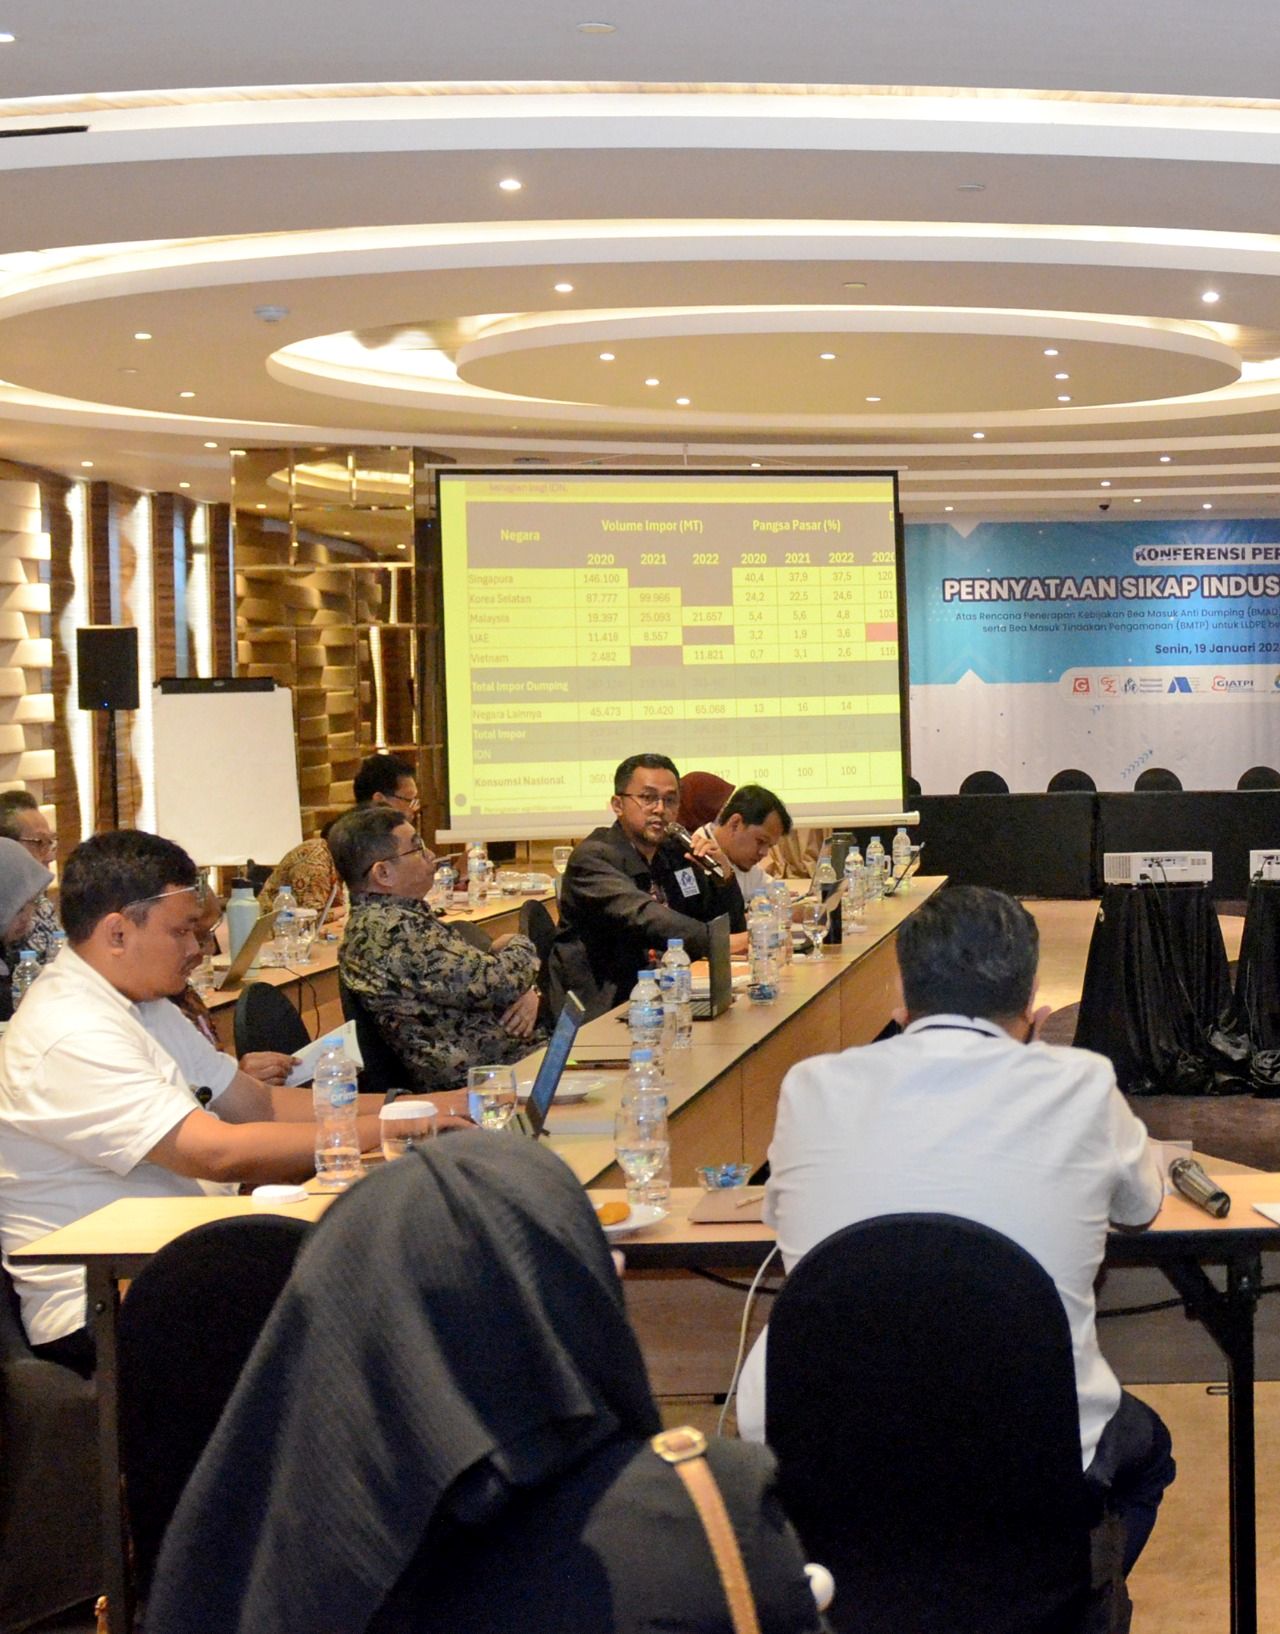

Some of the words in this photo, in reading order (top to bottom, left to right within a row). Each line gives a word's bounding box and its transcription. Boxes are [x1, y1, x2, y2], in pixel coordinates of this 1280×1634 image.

[602, 520, 643, 532] Volume
[646, 520, 677, 533] Impor
[680, 520, 703, 533] (MT)
[753, 520, 790, 532] Pangsa
[793, 520, 821, 531] Pasar
[824, 520, 841, 533] (%)
[501, 530, 541, 543] Negara
[587, 554, 614, 565] 2020
[640, 553, 667, 565] 2021
[692, 553, 719, 565] 2022
[740, 553, 767, 564] 2020
[785, 553, 810, 564] 2021
[829, 552, 854, 563] 2022
[1135, 547, 1246, 561] KONFERENSI
[468, 574, 513, 585] Singapura
[584, 574, 620, 583] 146.100
[745, 573, 764, 583] 40,4
[789, 572, 808, 583] 37,9
[832, 571, 851, 582] 37,5
[877, 571, 893, 580] 120
[944, 578, 1117, 601] PERNYATAAN
[1122, 575, 1198, 599] SIKAP
[586, 593, 617, 603] 87.777
[745, 592, 765, 602] 24,2
[878, 590, 893, 600] 101
[470, 614, 510, 624] Malaysia
[692, 612, 723, 622] 21.657
[749, 611, 763, 621] 5,4
[793, 610, 807, 620] 5,6
[836, 609, 850, 620] 4,8
[956, 612, 976, 620] Atas
[1024, 612, 1075, 621] Penerapan
[1078, 610, 1124, 620] Kebijakan
[1128, 610, 1145, 618] Bea
[1148, 609, 1178, 617] Masuk
[1201, 609, 1244, 618] Dumping
[983, 624, 1006, 632] serta
[1009, 624, 1027, 632] Bea
[1062, 622, 1106, 632] Tindakan
[1109, 622, 1173, 632] Pengamanan
[1176, 620, 1208, 630] (BMTP)
[1212, 621, 1239, 629] untuk
[749, 630, 763, 640] 3,2
[794, 629, 807, 639] 1,9
[837, 628, 850, 639] 3,6
[1155, 644, 1192, 655] Senin,
[1195, 644, 1206, 653] 19
[1209, 642, 1255, 653] Januari
[471, 653, 508, 663] Vietnam
[591, 652, 616, 661] 2.482
[794, 648, 807, 658] 3,1
[473, 681, 494, 691] Total
[497, 682, 524, 693] Impor
[526, 681, 568, 692] Dumping
[472, 710, 504, 721] Negara
[507, 710, 542, 719] Lainnya
[590, 706, 621, 716] 45.473
[644, 706, 673, 716] 70.420
[474, 729, 496, 738] Total
[498, 729, 526, 740] Impor
[475, 777, 521, 787] Konsumsi
[754, 769, 768, 778] 100
[797, 768, 813, 777] 100
[841, 766, 856, 775] 100
